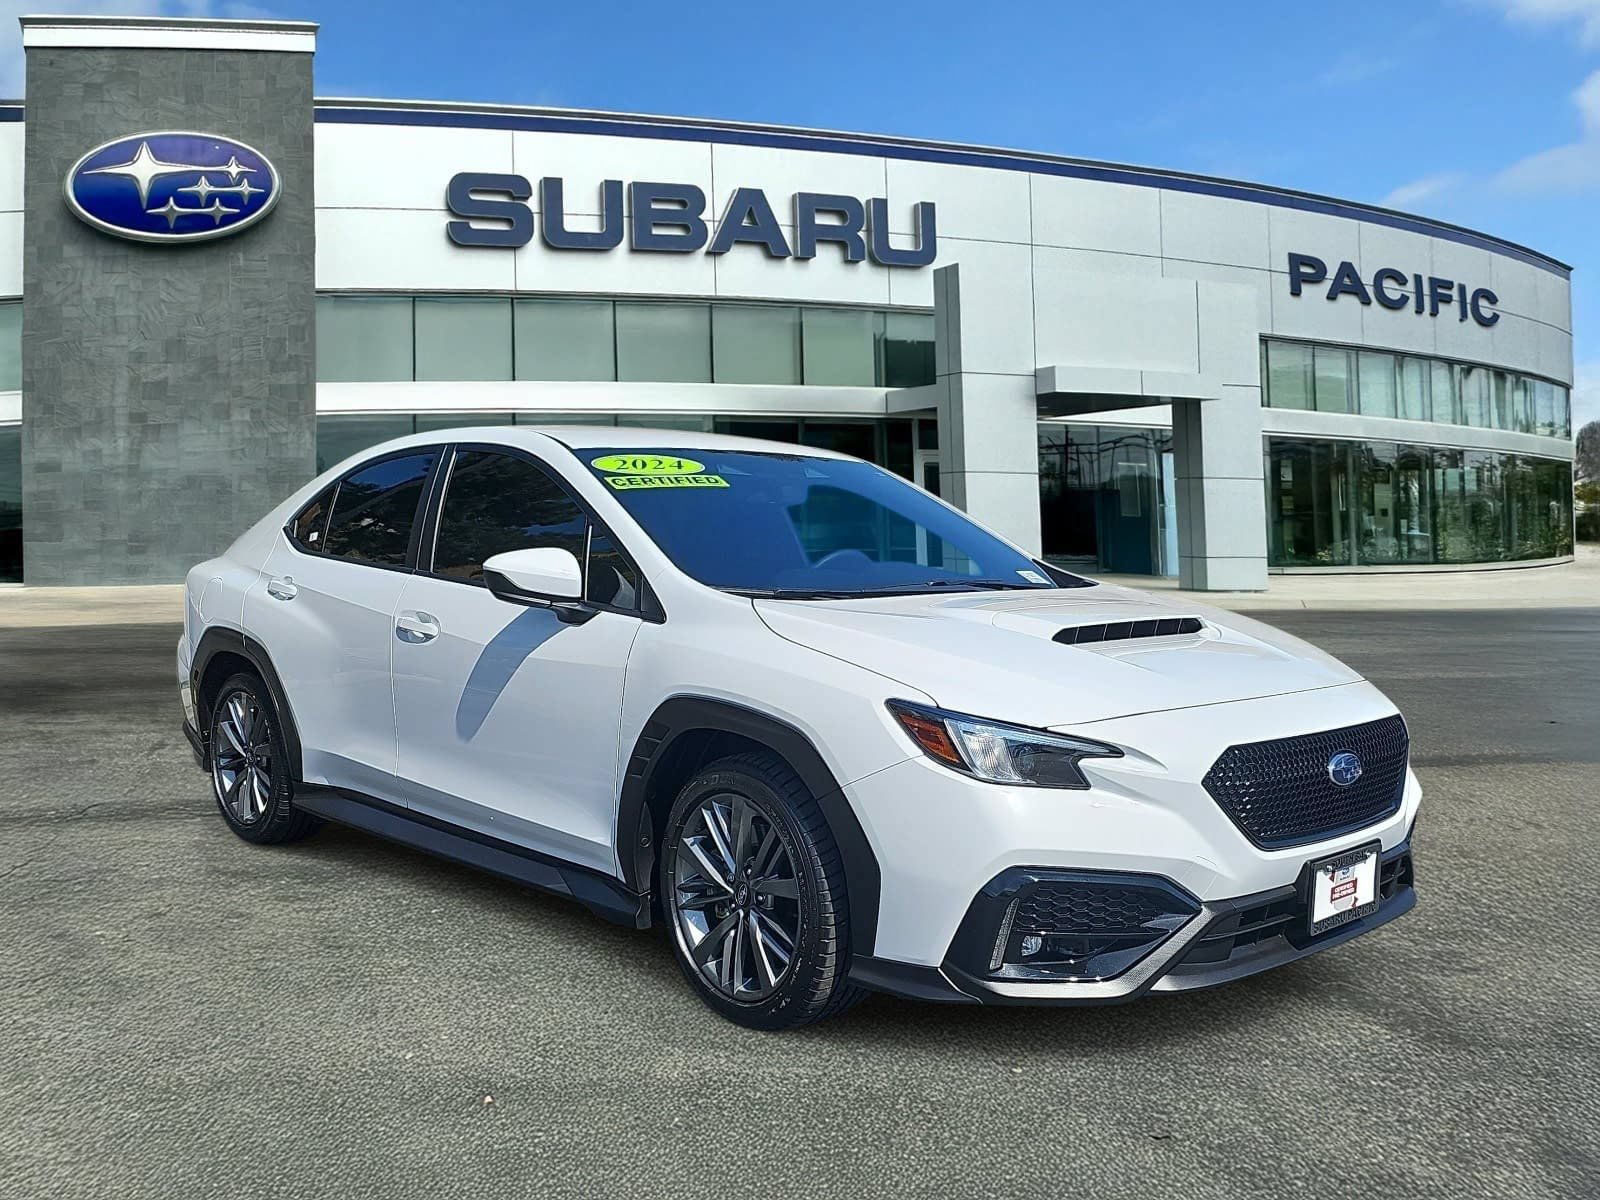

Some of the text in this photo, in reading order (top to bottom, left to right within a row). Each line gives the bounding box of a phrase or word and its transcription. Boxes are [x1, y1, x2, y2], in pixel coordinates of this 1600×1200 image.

[446, 172, 937, 267] SUBARU
[1288, 252, 1499, 327] PACIFIC
[612, 475, 719, 487] CERTIFIED
[614, 458, 684, 470] 2024
